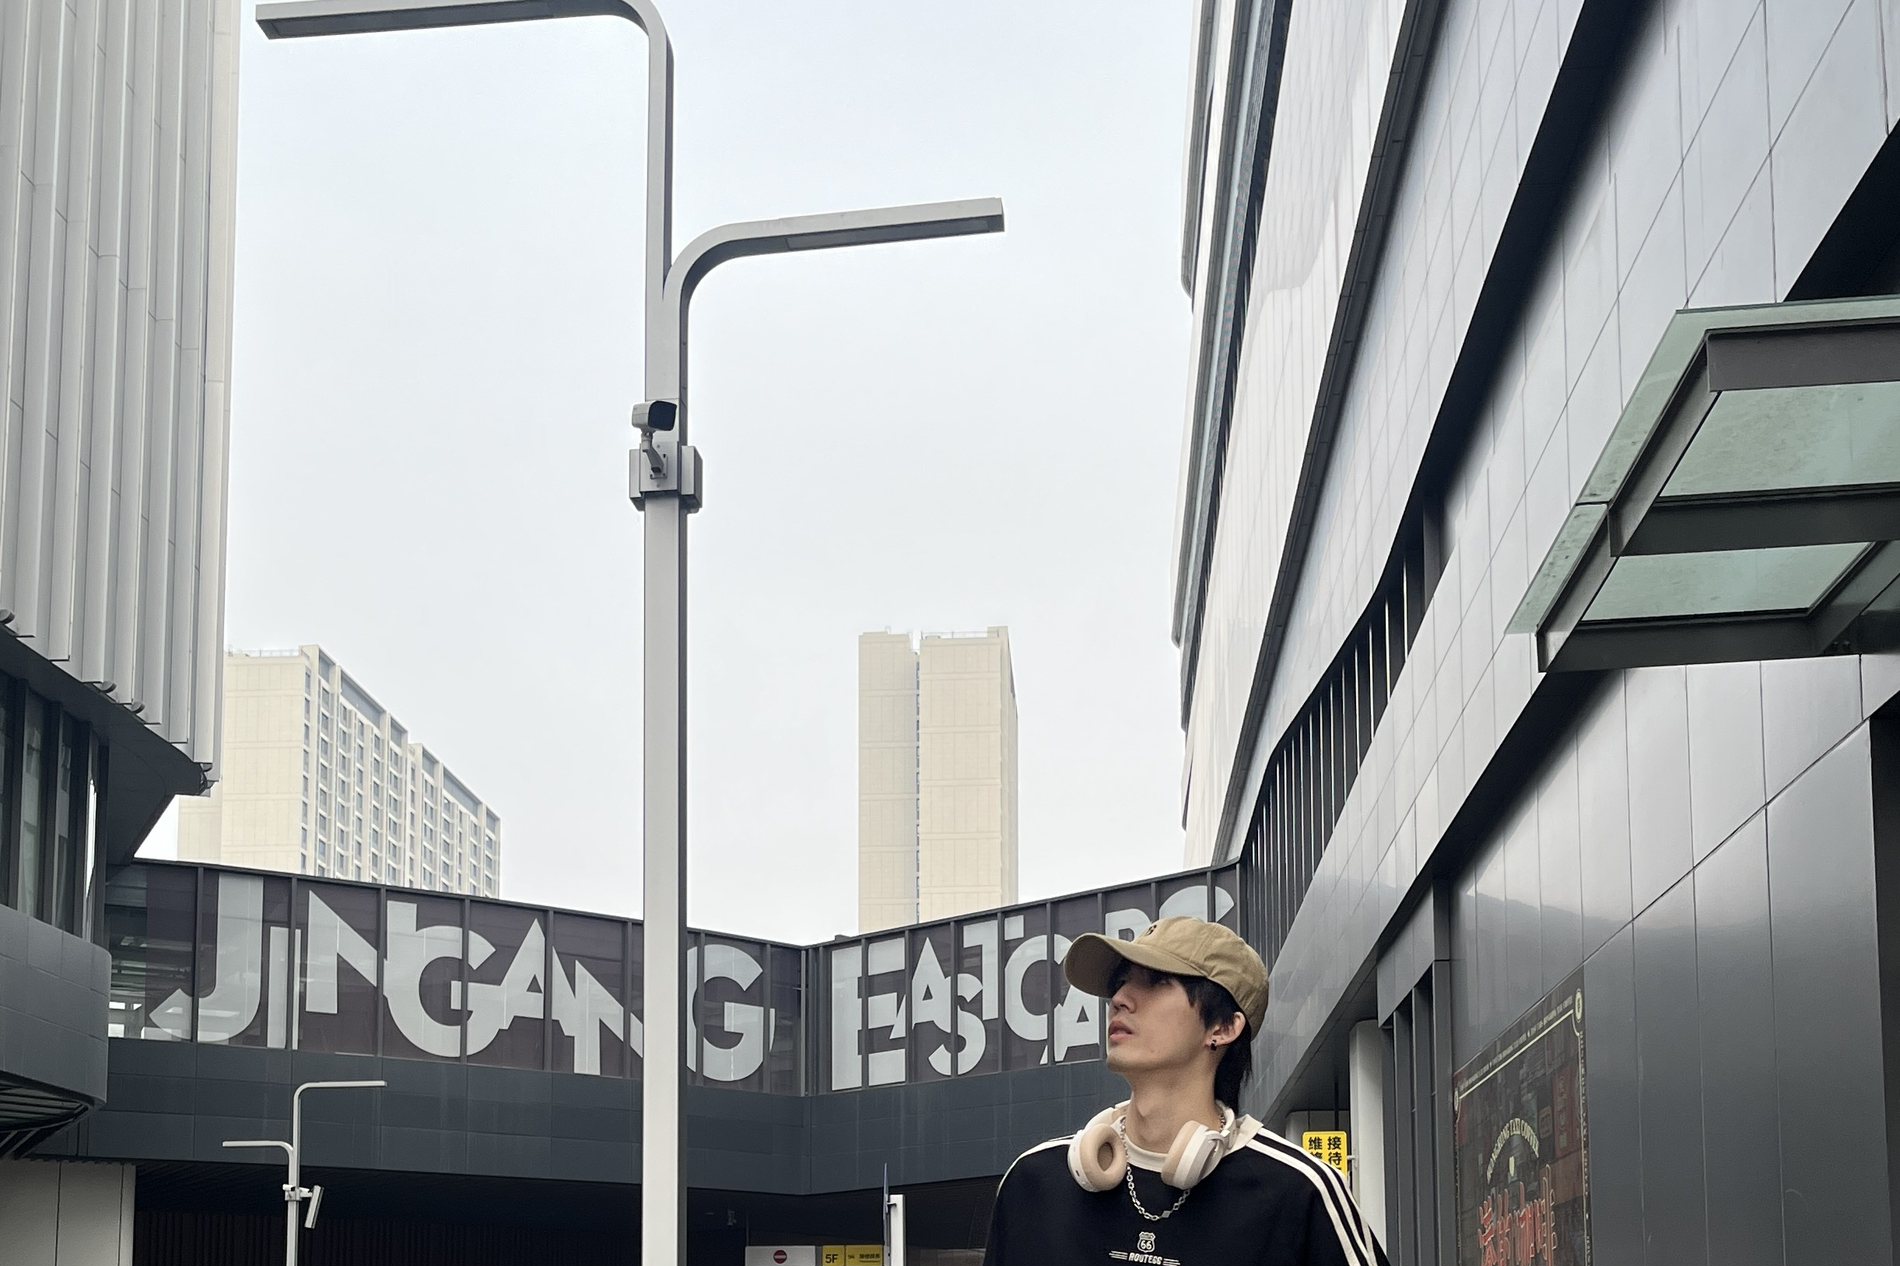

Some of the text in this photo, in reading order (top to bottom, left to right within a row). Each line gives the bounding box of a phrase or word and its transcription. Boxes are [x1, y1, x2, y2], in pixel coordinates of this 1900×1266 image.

[148, 873, 1235, 1091] JINGANG EAST CA
[1140, 1240, 1153, 1250] 66
[825, 1253, 839, 1264] 5F
